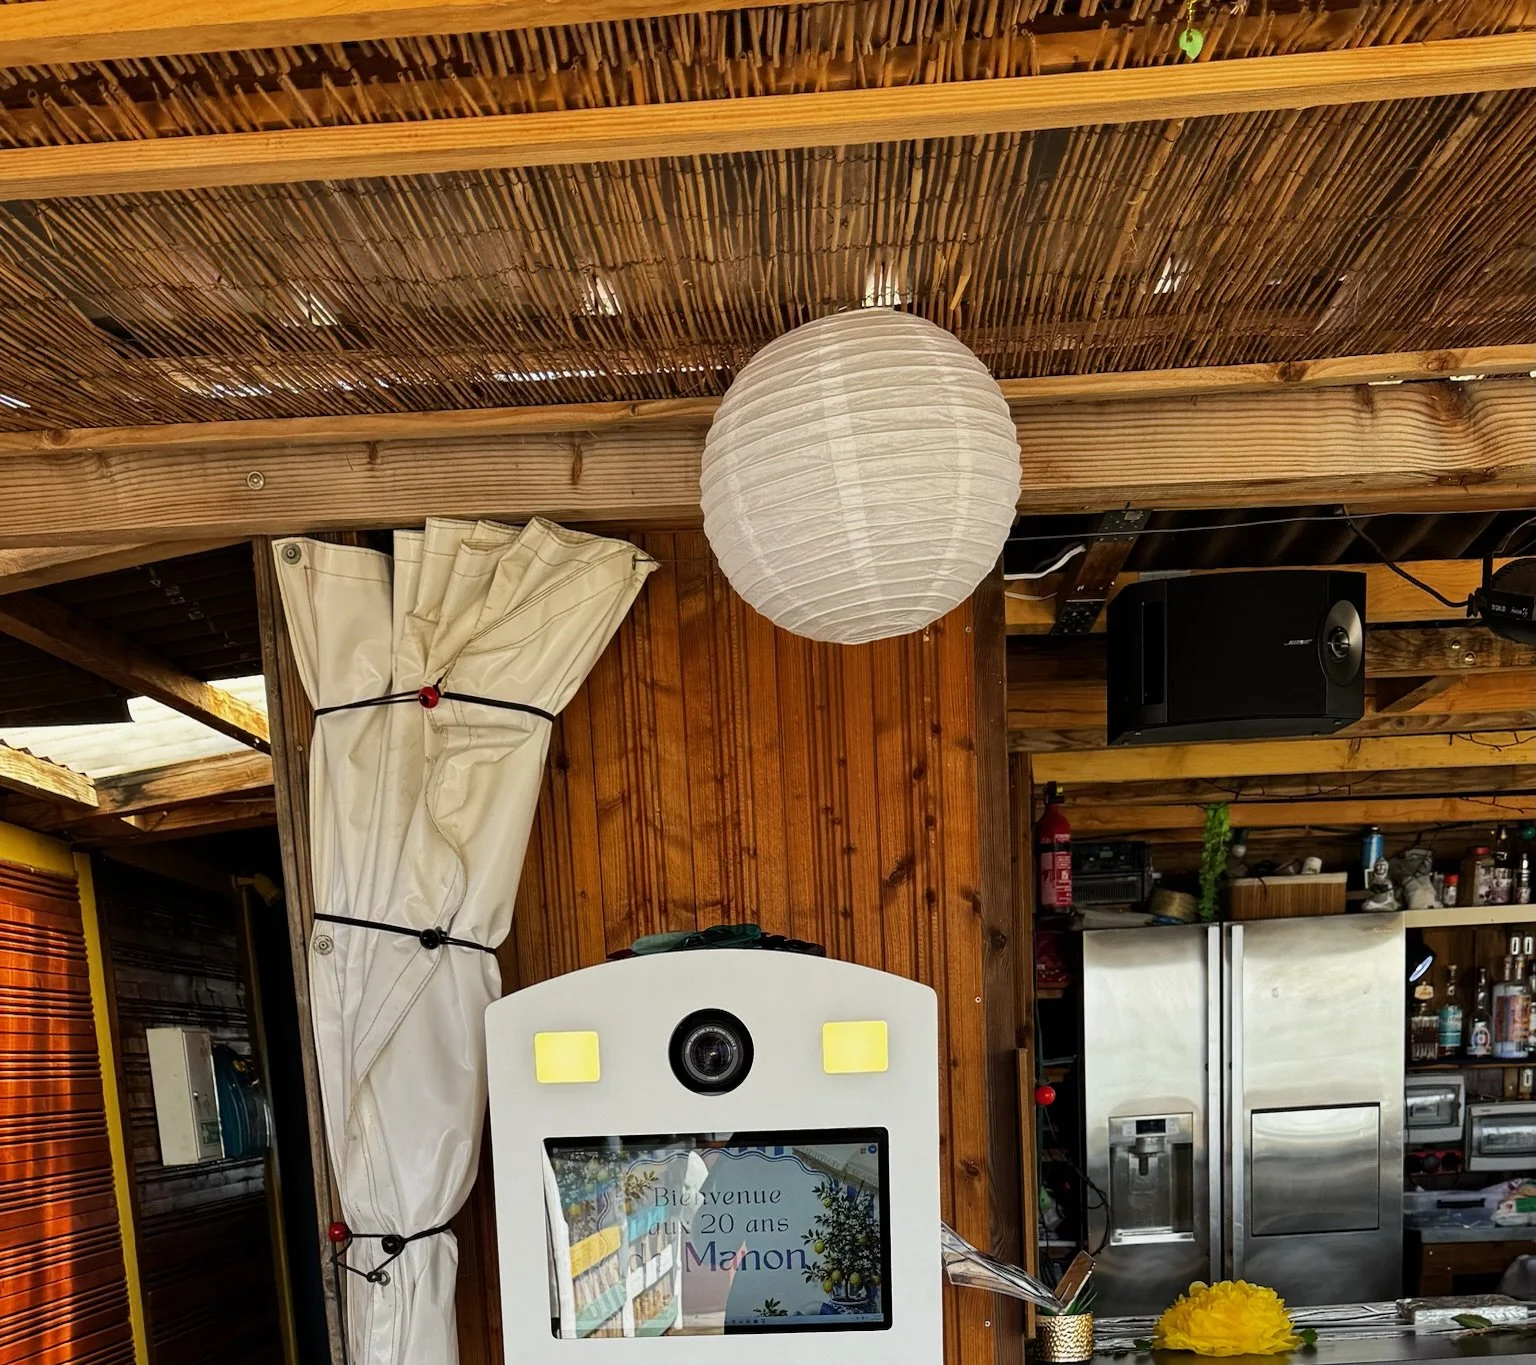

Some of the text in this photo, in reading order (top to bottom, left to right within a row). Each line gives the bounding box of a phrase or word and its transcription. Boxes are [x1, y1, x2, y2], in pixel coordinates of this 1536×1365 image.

[654, 1187, 781, 1206] Bienvenue
[648, 1213, 789, 1235] aux 20 ans
[685, 1241, 806, 1272] Manon
